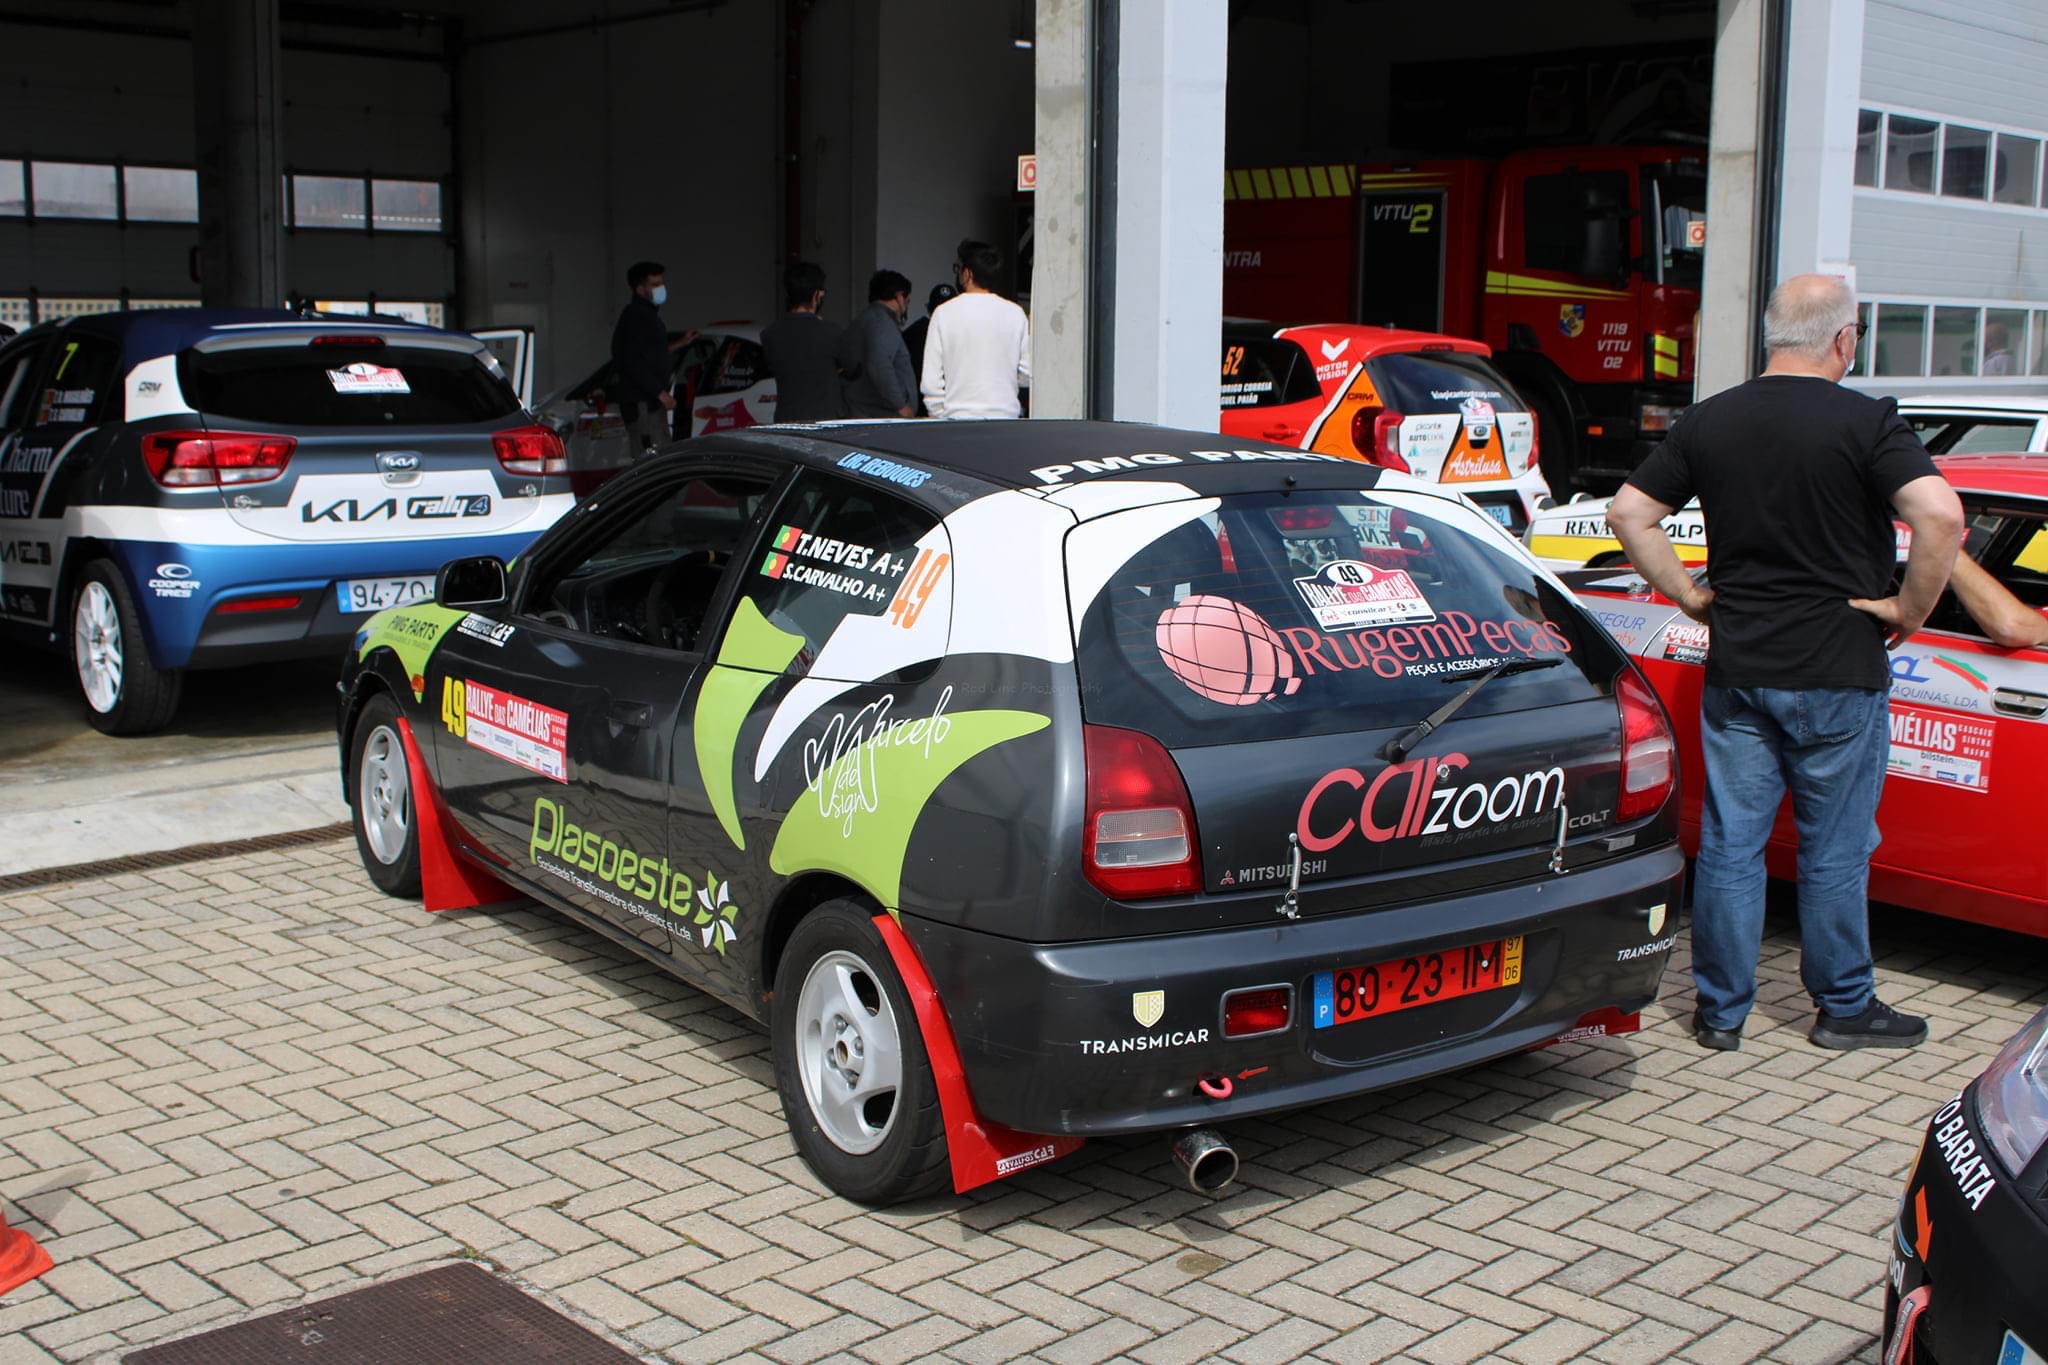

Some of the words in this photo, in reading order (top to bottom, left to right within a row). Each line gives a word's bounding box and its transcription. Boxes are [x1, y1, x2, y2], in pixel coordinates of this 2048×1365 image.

[1408, 204, 1434, 233] 2
[1597, 340, 1631, 352] VTTU
[1222, 346, 1245, 376] 52
[1315, 361, 1349, 374] MOTOR
[1316, 370, 1348, 382] VISION
[1030, 453, 1184, 484] PMG
[302, 498, 397, 523] KIA
[796, 533, 874, 570] T.NEVES
[148, 579, 200, 590] COOPER
[1337, 565, 1363, 584] 49
[155, 588, 191, 598] TIRES
[889, 547, 951, 630] 49
[1279, 610, 1573, 680] RugemPeças
[1405, 664, 1438, 677] PEÇAS
[1439, 662, 1446, 672] E
[442, 675, 466, 739] 49
[465, 684, 495, 721] RALLYE
[506, 698, 551, 743] CAMÉLIAS
[1568, 810, 1612, 829] COLT
[1506, 936, 1521, 951] 97
[1504, 965, 1519, 980] 06
[1319, 1004, 1329, 1019] P
[1080, 1028, 1209, 1054] TRANSMICAR
[1935, 1114, 1996, 1211] BARATA
